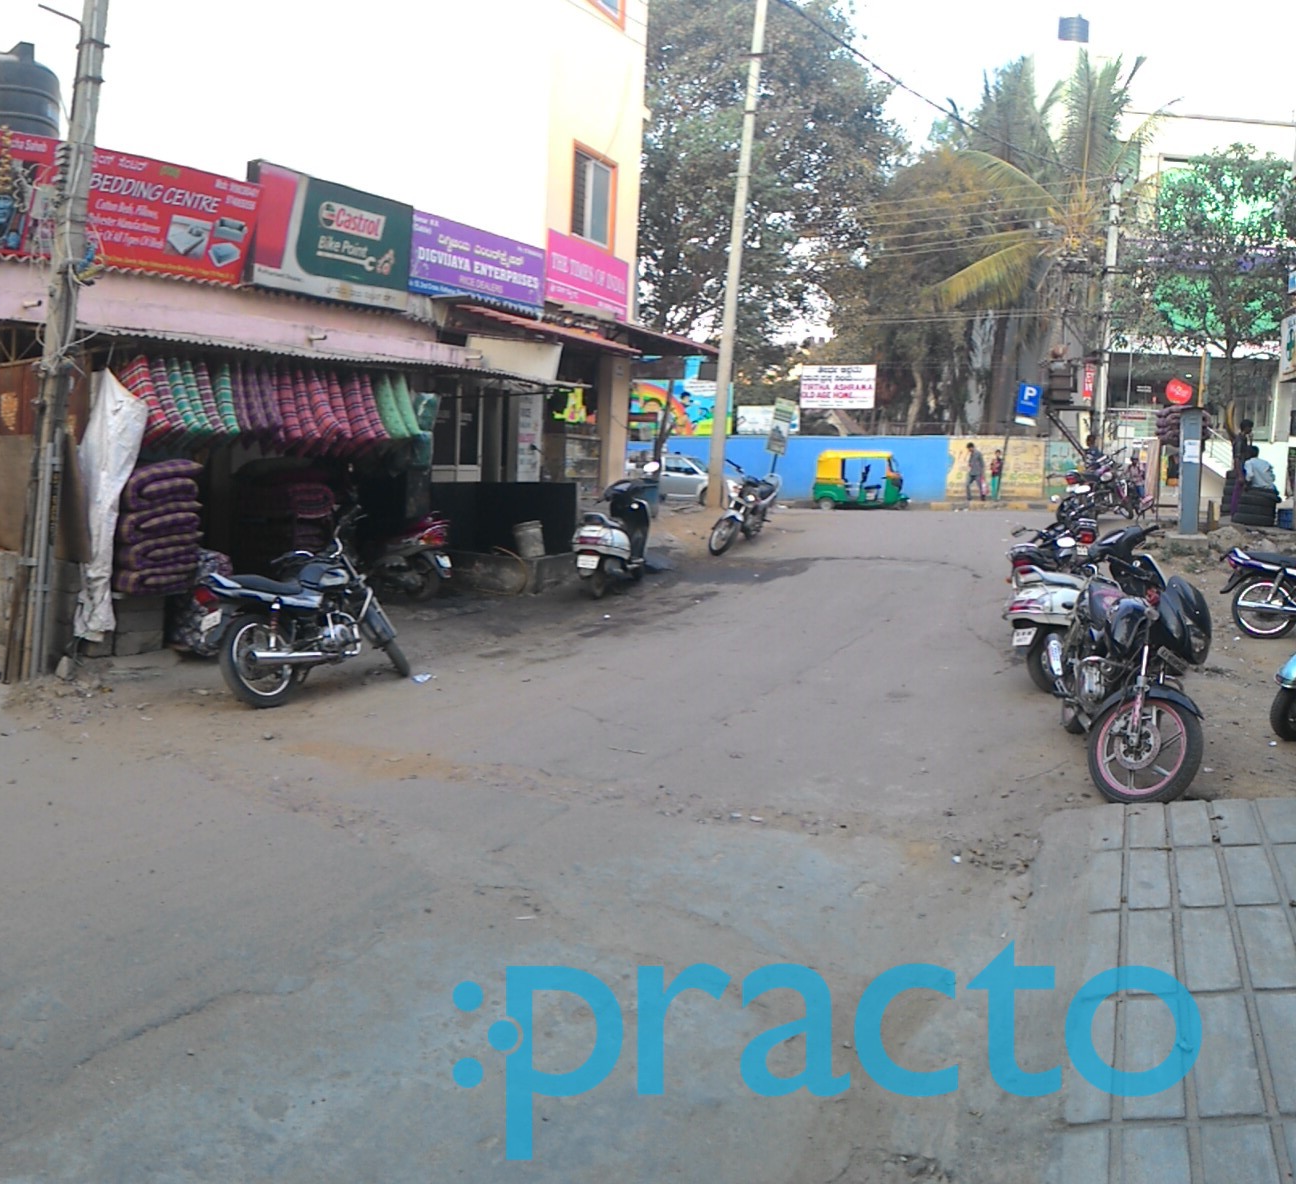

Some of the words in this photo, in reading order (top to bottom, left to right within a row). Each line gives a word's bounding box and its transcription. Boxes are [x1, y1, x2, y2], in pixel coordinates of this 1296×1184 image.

[90, 172, 165, 202] BEDDING
[162, 187, 222, 214] CENTRE
[335, 207, 382, 236] Castrol
[318, 235, 342, 252] Bike
[341, 240, 368, 258] Point
[418, 246, 471, 272] DIGVIJAYA
[473, 261, 539, 289] ENTERPRISES
[1024, 386, 1037, 400] P
